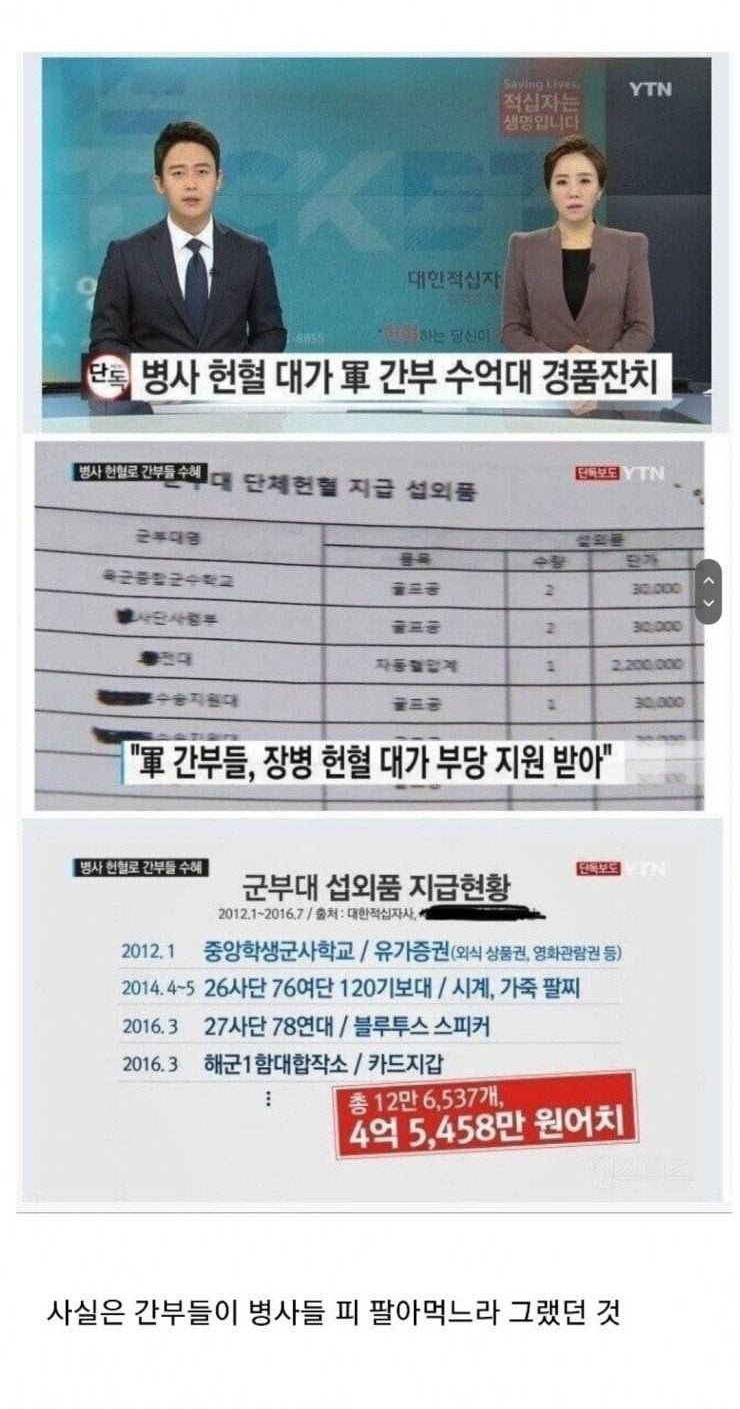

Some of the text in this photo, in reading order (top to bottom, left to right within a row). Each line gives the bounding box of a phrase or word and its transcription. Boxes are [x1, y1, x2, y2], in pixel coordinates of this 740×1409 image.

[503, 92, 580, 113] 적십자는
[503, 115, 580, 131] 생명입니다
[408, 270, 501, 290] 대한적십자
[243, 474, 338, 497] 단체헌혈
[350, 478, 393, 499] 지급
[407, 481, 476, 502] 섭외품
[243, 874, 511, 902] 군부대 섭외품 지급현황
[218, 907, 304, 920] 2012.1~2016.7
[347, 907, 417, 921] 대한적십자사,
[204, 940, 355, 963] 중앙학생군사학교
[486, 945, 530, 962] 상품권,
[533, 945, 600, 961] 영화관람권
[603, 945, 622, 962] 등)
[204, 977, 580, 1000] 26사단 76여단 120기보대 시계, 가죽 팔찌
[204, 1015, 490, 1038] 27사단 78연대 블루투스 스피커
[368, 1053, 445, 1076] 카드지갑
[349, 1085, 504, 1115] 총 12만 6,537개,
[349, 1103, 625, 1150] 4억 5,458만 원어치
